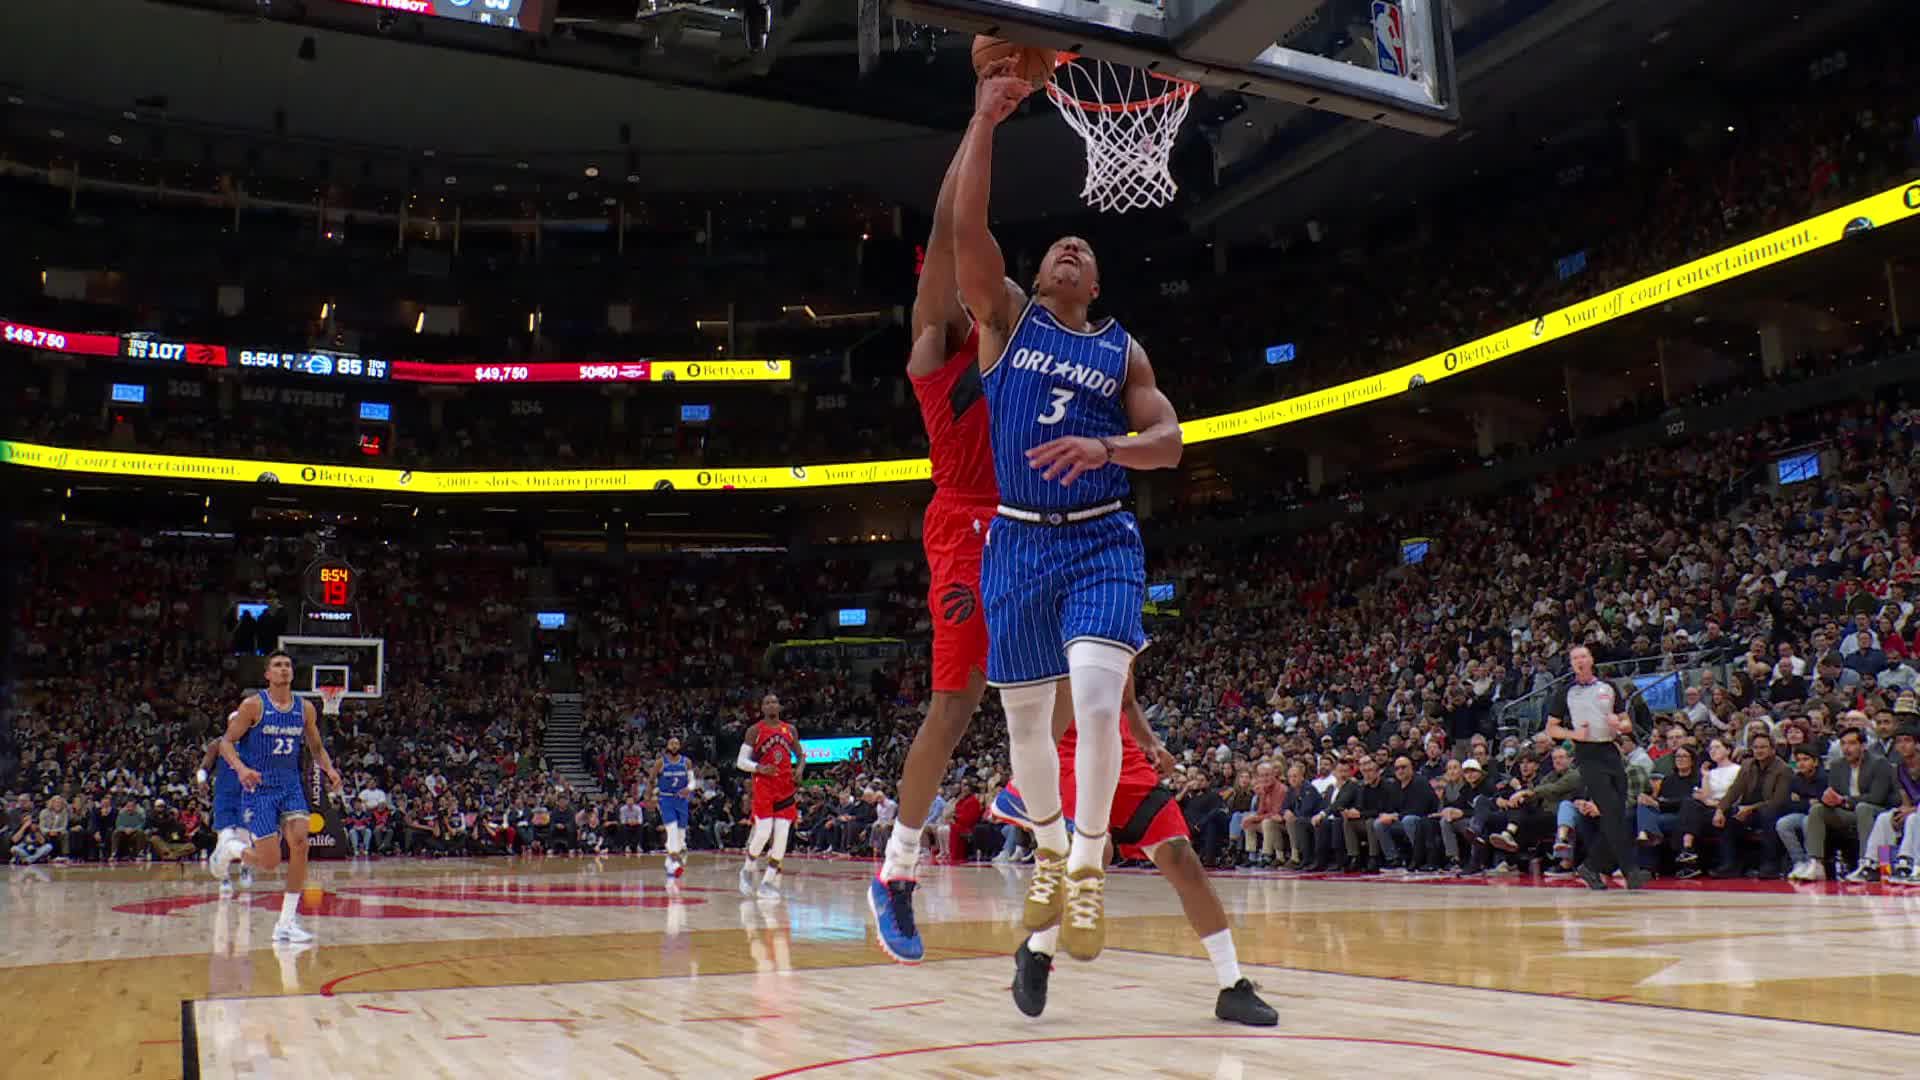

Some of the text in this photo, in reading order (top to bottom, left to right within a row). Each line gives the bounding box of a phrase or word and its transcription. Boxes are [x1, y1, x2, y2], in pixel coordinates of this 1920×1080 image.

[1564, 229, 1820, 328] Your off court entertainment.
[148, 341, 185, 361] 107
[240, 350, 279, 368] 8:54
[1459, 338, 1511, 367] Betty.ca
[337, 358, 363, 375] 85
[474, 366, 529, 382] $49,750
[704, 364, 755, 378] Betty.ca
[1037, 387, 1075, 424] 3
[1254, 410, 1287, 424] slots.
[1289, 395, 1340, 414] Ontario
[1343, 379, 1388, 405] proud.
[9, 446, 242, 476] Your off court entertainment.
[319, 469, 375, 485] Betty.ca
[714, 472, 768, 485] Betty.ca
[824, 468, 855, 480] Your
[859, 465, 879, 480] off
[883, 463, 921, 476] court
[526, 475, 581, 487] Ontario
[584, 473, 632, 488] proud.
[320, 568, 348, 582] 8:54
[325, 581, 347, 605] 19
[320, 612, 352, 621] TISSOT
[272, 738, 294, 755] 23
